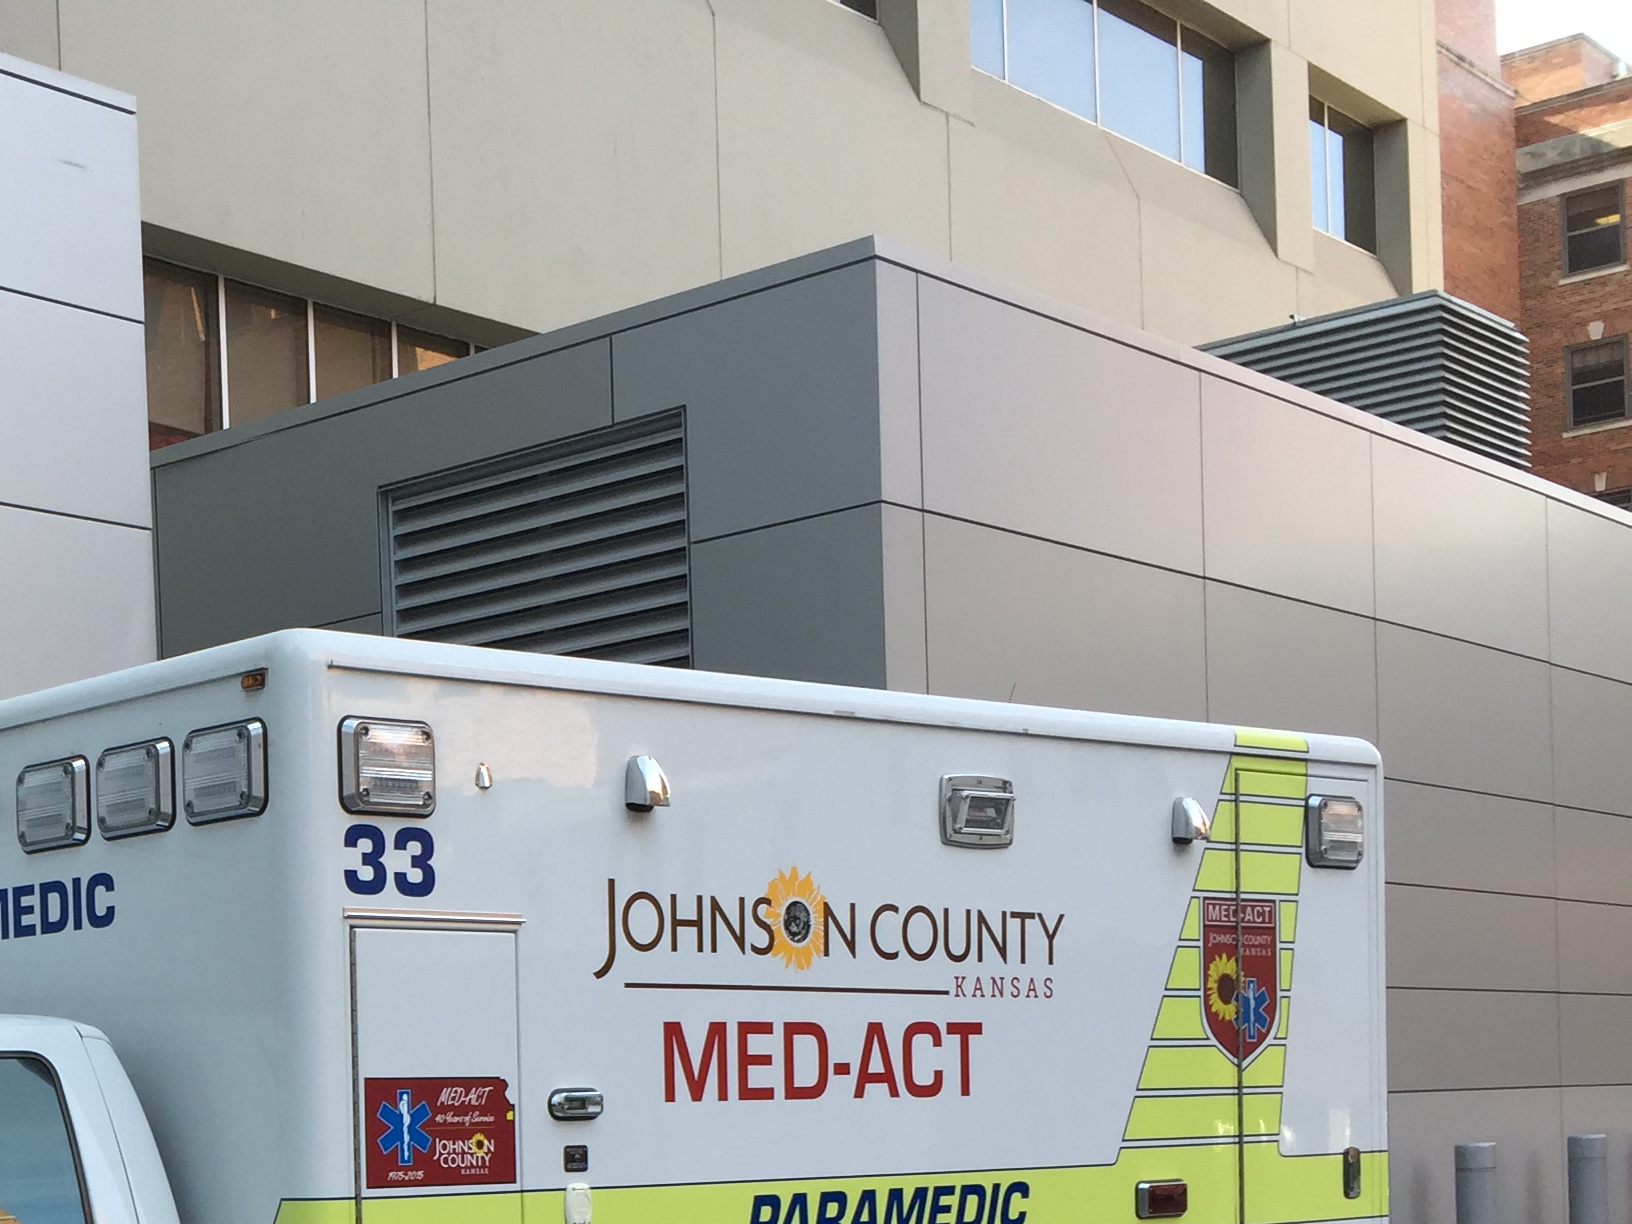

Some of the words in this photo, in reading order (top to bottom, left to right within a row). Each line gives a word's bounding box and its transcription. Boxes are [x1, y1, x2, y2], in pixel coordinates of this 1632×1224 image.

[344, 823, 436, 898] 33
[1208, 904, 1271, 923] MED-ACT
[593, 877, 857, 980] JOHNSON
[870, 903, 1065, 966] COUNTY
[1243, 934, 1272, 945] COUNTY
[952, 975, 1055, 999] KANSAS
[663, 1020, 984, 1103] MED-ACT
[437, 1086, 494, 1107] MED-ACT
[471, 1111, 495, 1123] Service
[433, 1137, 495, 1160] JOHNSON
[440, 1153, 492, 1168] COUNTY
